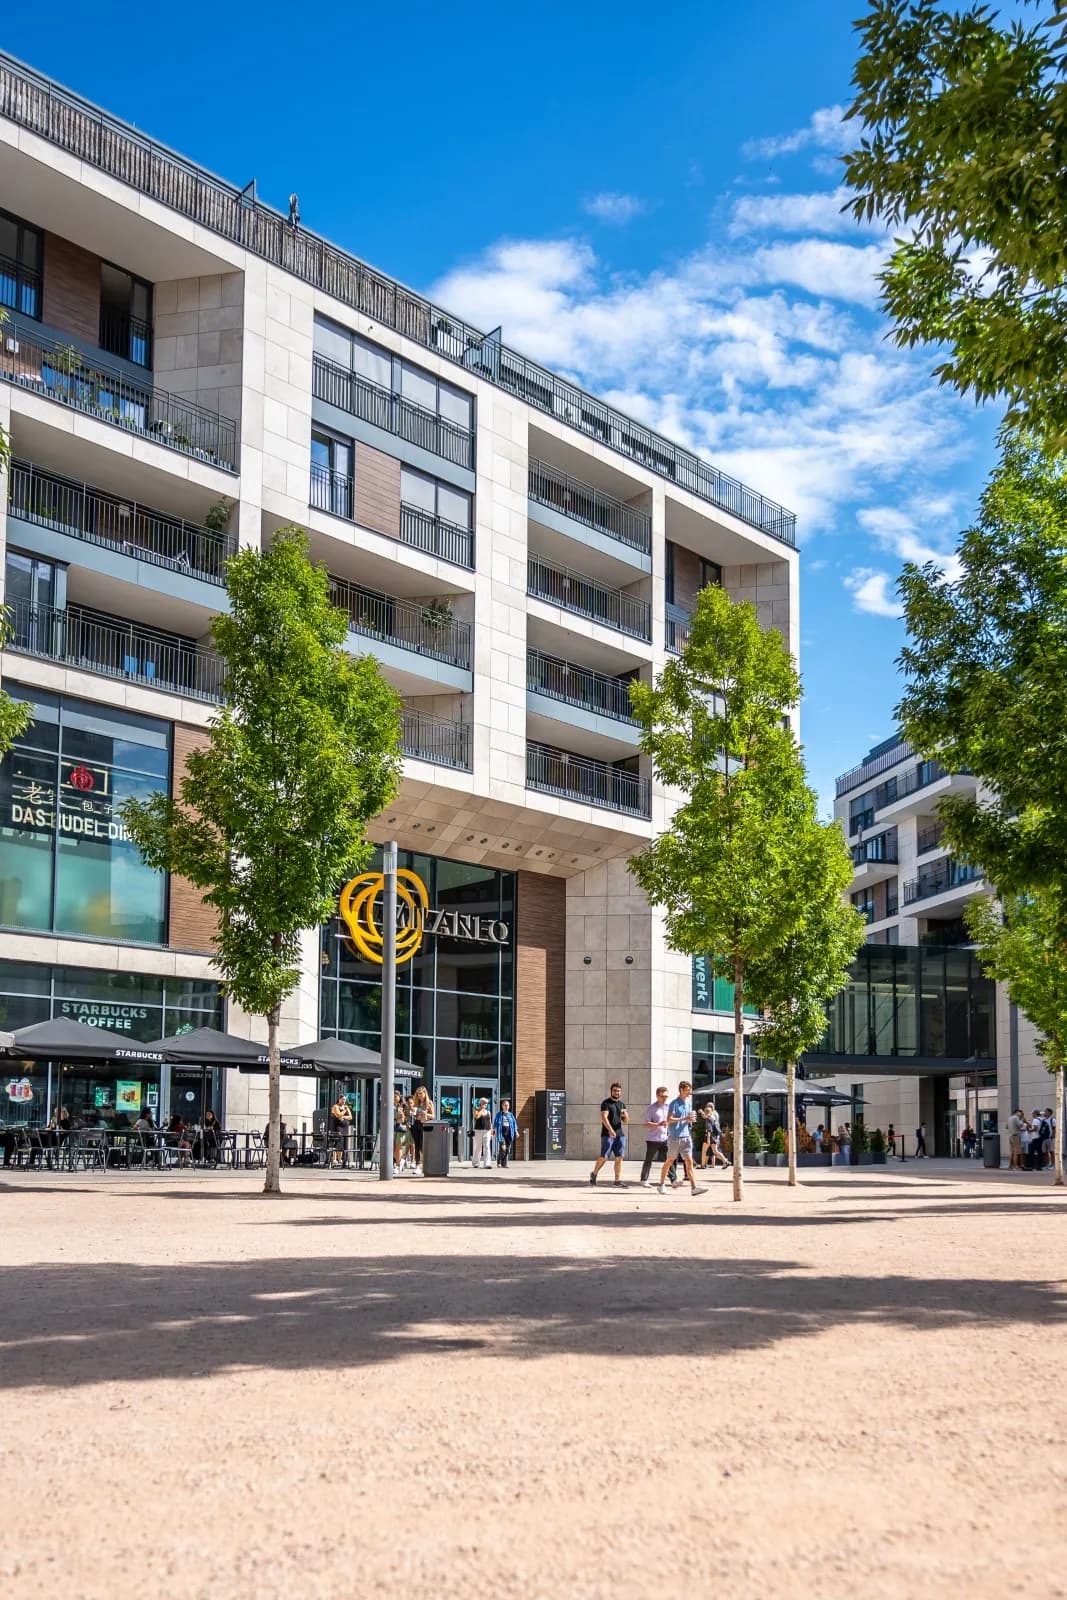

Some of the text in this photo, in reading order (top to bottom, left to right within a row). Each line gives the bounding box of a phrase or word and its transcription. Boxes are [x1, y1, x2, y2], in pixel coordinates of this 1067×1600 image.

[12, 804, 46, 827] DAS
[62, 1002, 148, 1019] STARBUCKS
[78, 1016, 132, 1029] COFFEE
[115, 1049, 163, 1060] STARBUCKS
[257, 1055, 299, 1065] STAUCKS
